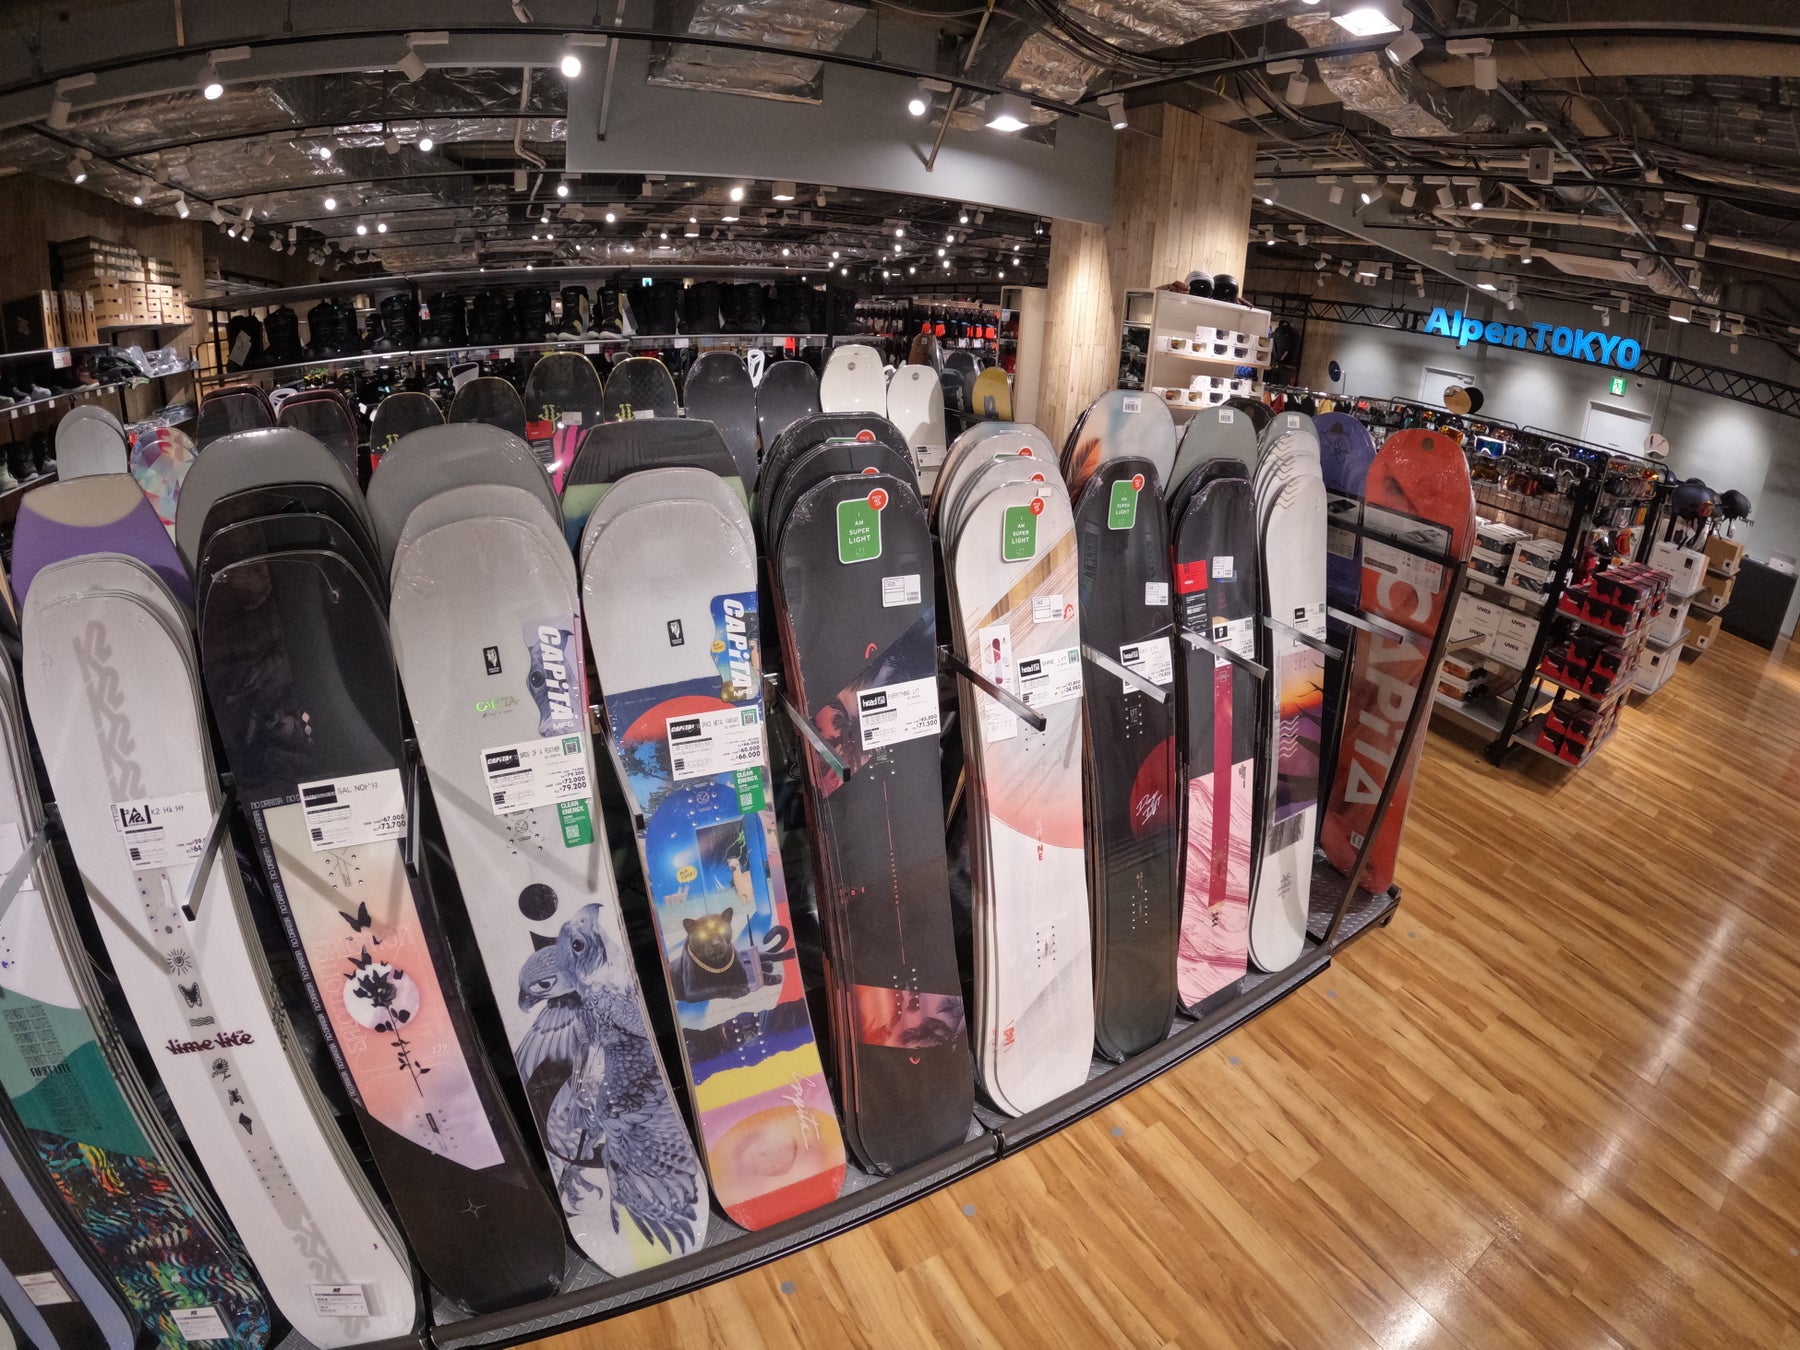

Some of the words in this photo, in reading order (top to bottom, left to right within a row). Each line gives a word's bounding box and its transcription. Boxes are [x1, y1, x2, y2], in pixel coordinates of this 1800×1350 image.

[1424, 307, 1528, 347] Alpen
[1533, 321, 1642, 369] TOKYO
[849, 527, 870, 535] SUPER
[848, 535, 871, 544] LIGHT
[1476, 605, 1491, 615] uvex
[1511, 618, 1526, 629] uvex
[723, 598, 752, 688] CAPiTA
[1504, 641, 1519, 651] uvex
[538, 625, 574, 720] CAPiTA
[1021, 663, 1033, 673] head
[733, 687, 753, 697] MFG
[862, 697, 878, 707] head
[552, 720, 575, 730] MFG
[337, 787, 352, 795] SAL
[561, 800, 579, 809] CLEAN
[165, 1039, 215, 1055] lime
[214, 1032, 254, 1048] lite
[30, 1065, 53, 1077] FIRST
[54, 1063, 72, 1074] LITE
